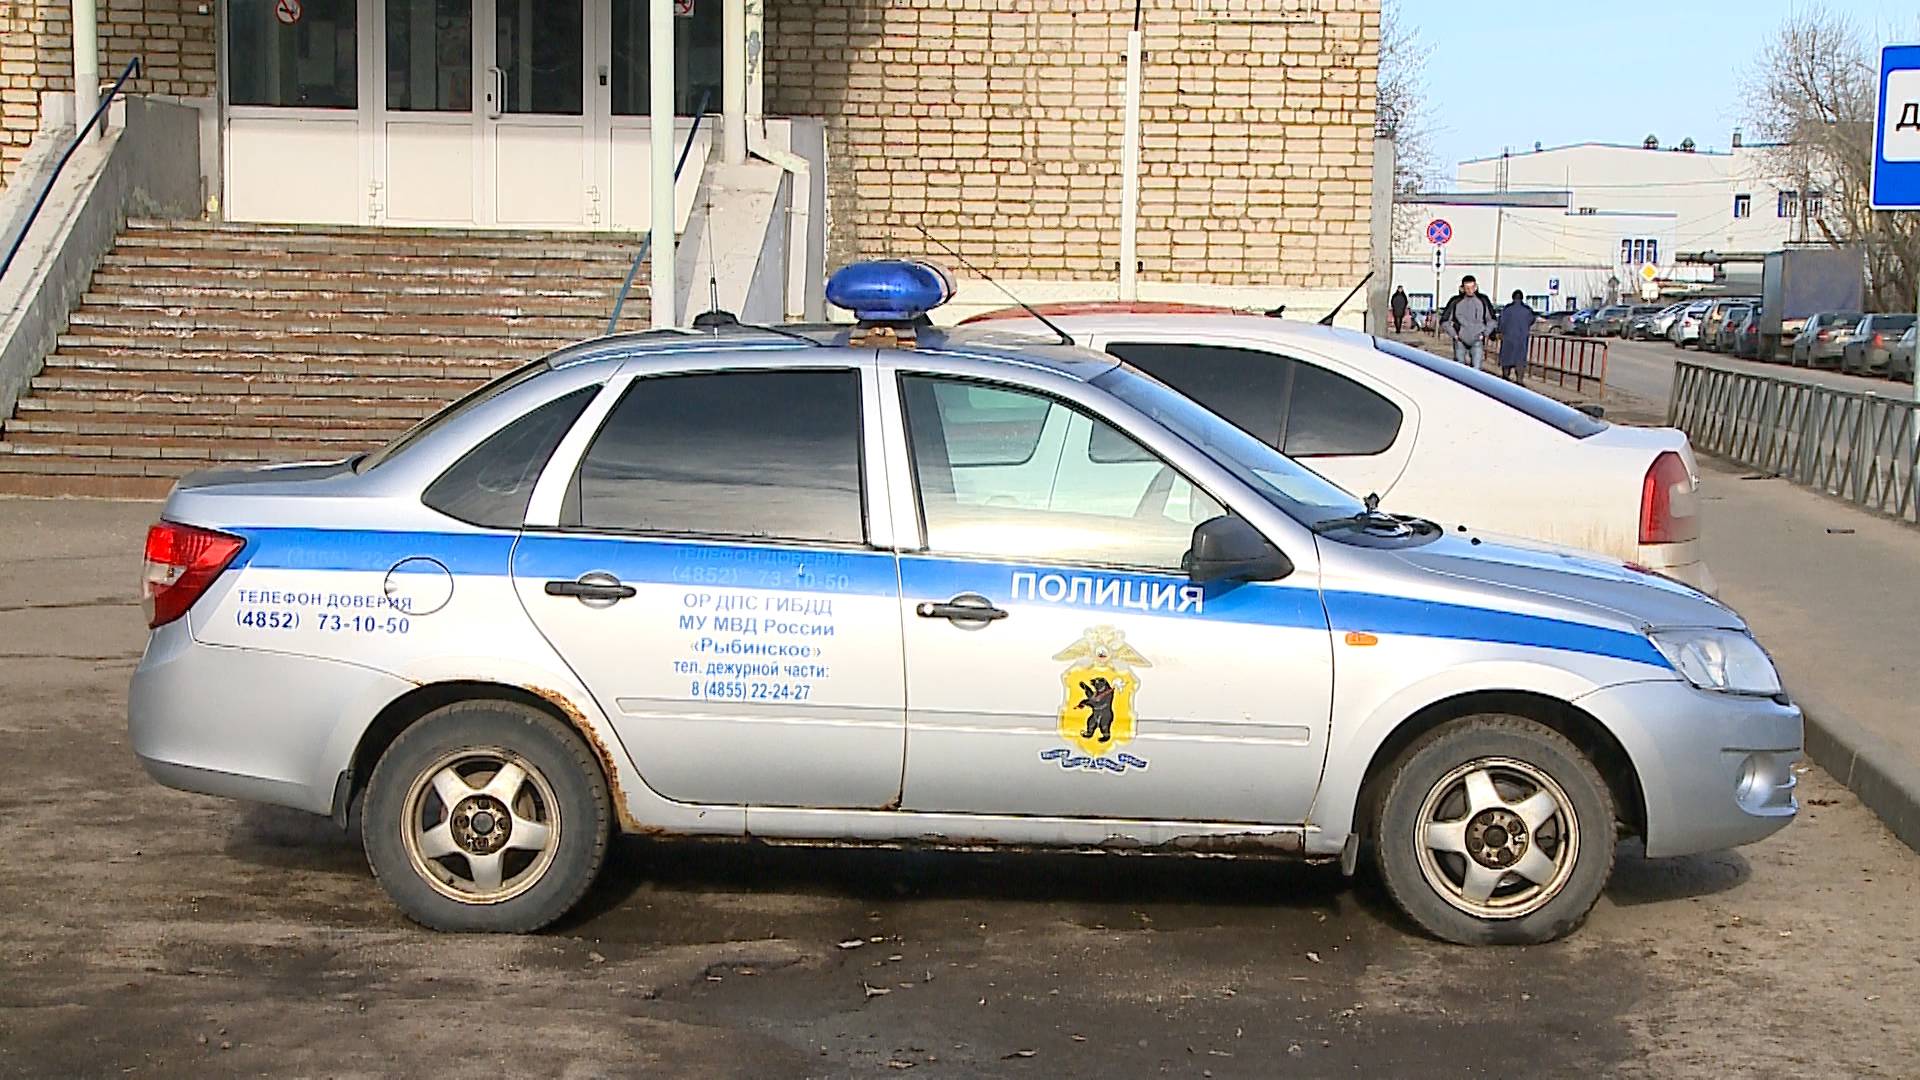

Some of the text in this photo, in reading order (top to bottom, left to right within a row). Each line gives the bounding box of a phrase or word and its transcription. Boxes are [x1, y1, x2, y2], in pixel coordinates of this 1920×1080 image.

[238, 589, 412, 610] ТЕЛЕФОН ДОВЕРИЯ
[1011, 571, 1205, 614] ПОЛИЦИЯ
[683, 593, 833, 617] ОР ДПС ГИБДД
[236, 610, 410, 634] (4852) 73-10-50
[679, 615, 835, 637] МУ МВД России
[690, 637, 822, 658] «Рыбинское»
[674, 661, 830, 679] тел. дежурной части:
[691, 681, 811, 700] 8 (4855) 22-24-27
